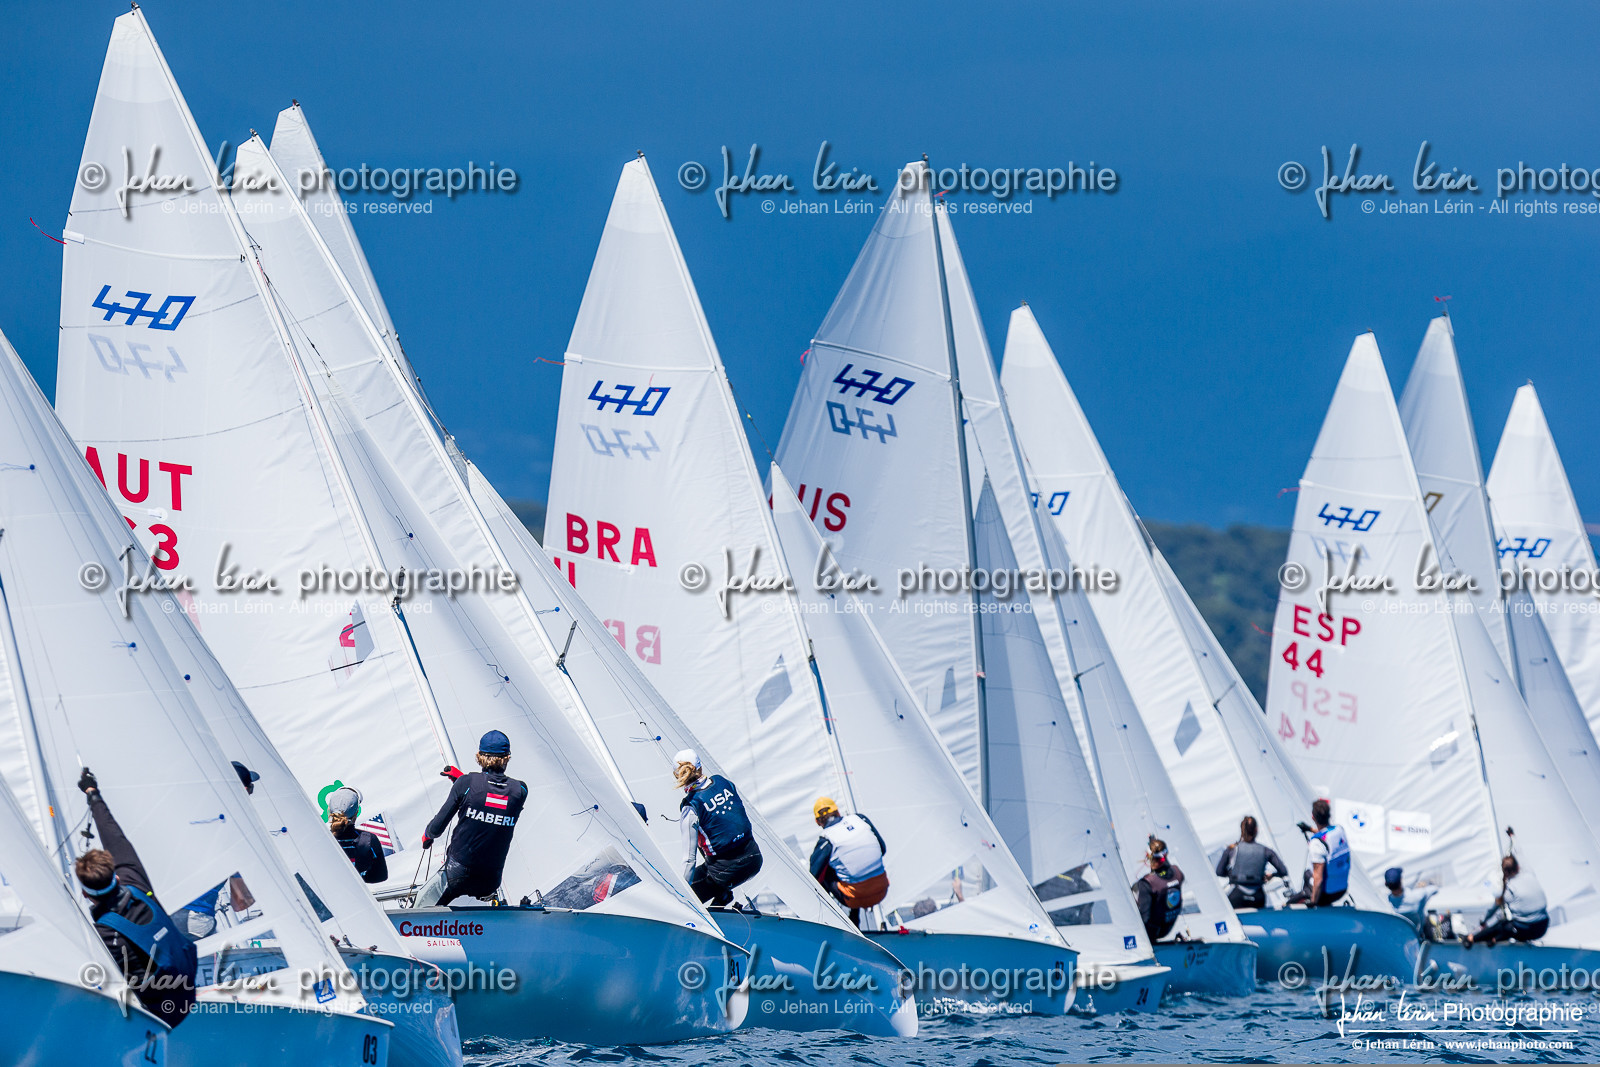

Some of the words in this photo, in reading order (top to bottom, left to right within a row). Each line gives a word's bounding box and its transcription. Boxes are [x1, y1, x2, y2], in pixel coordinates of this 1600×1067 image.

[92, 284, 197, 331] 470
[587, 380, 672, 416] 470
[832, 363, 916, 405] 470
[1318, 503, 1381, 531] 470
[566, 512, 658, 567] BRA
[1293, 604, 1362, 646] ESP
[1282, 641, 1324, 678] 44
[703, 788, 734, 812] USA
[466, 807, 515, 826] HABERL
[399, 920, 484, 937] Candidate
[427, 939, 462, 947] SAILING
[730, 958, 740, 985] 31
[363, 1034, 378, 1065] 03
